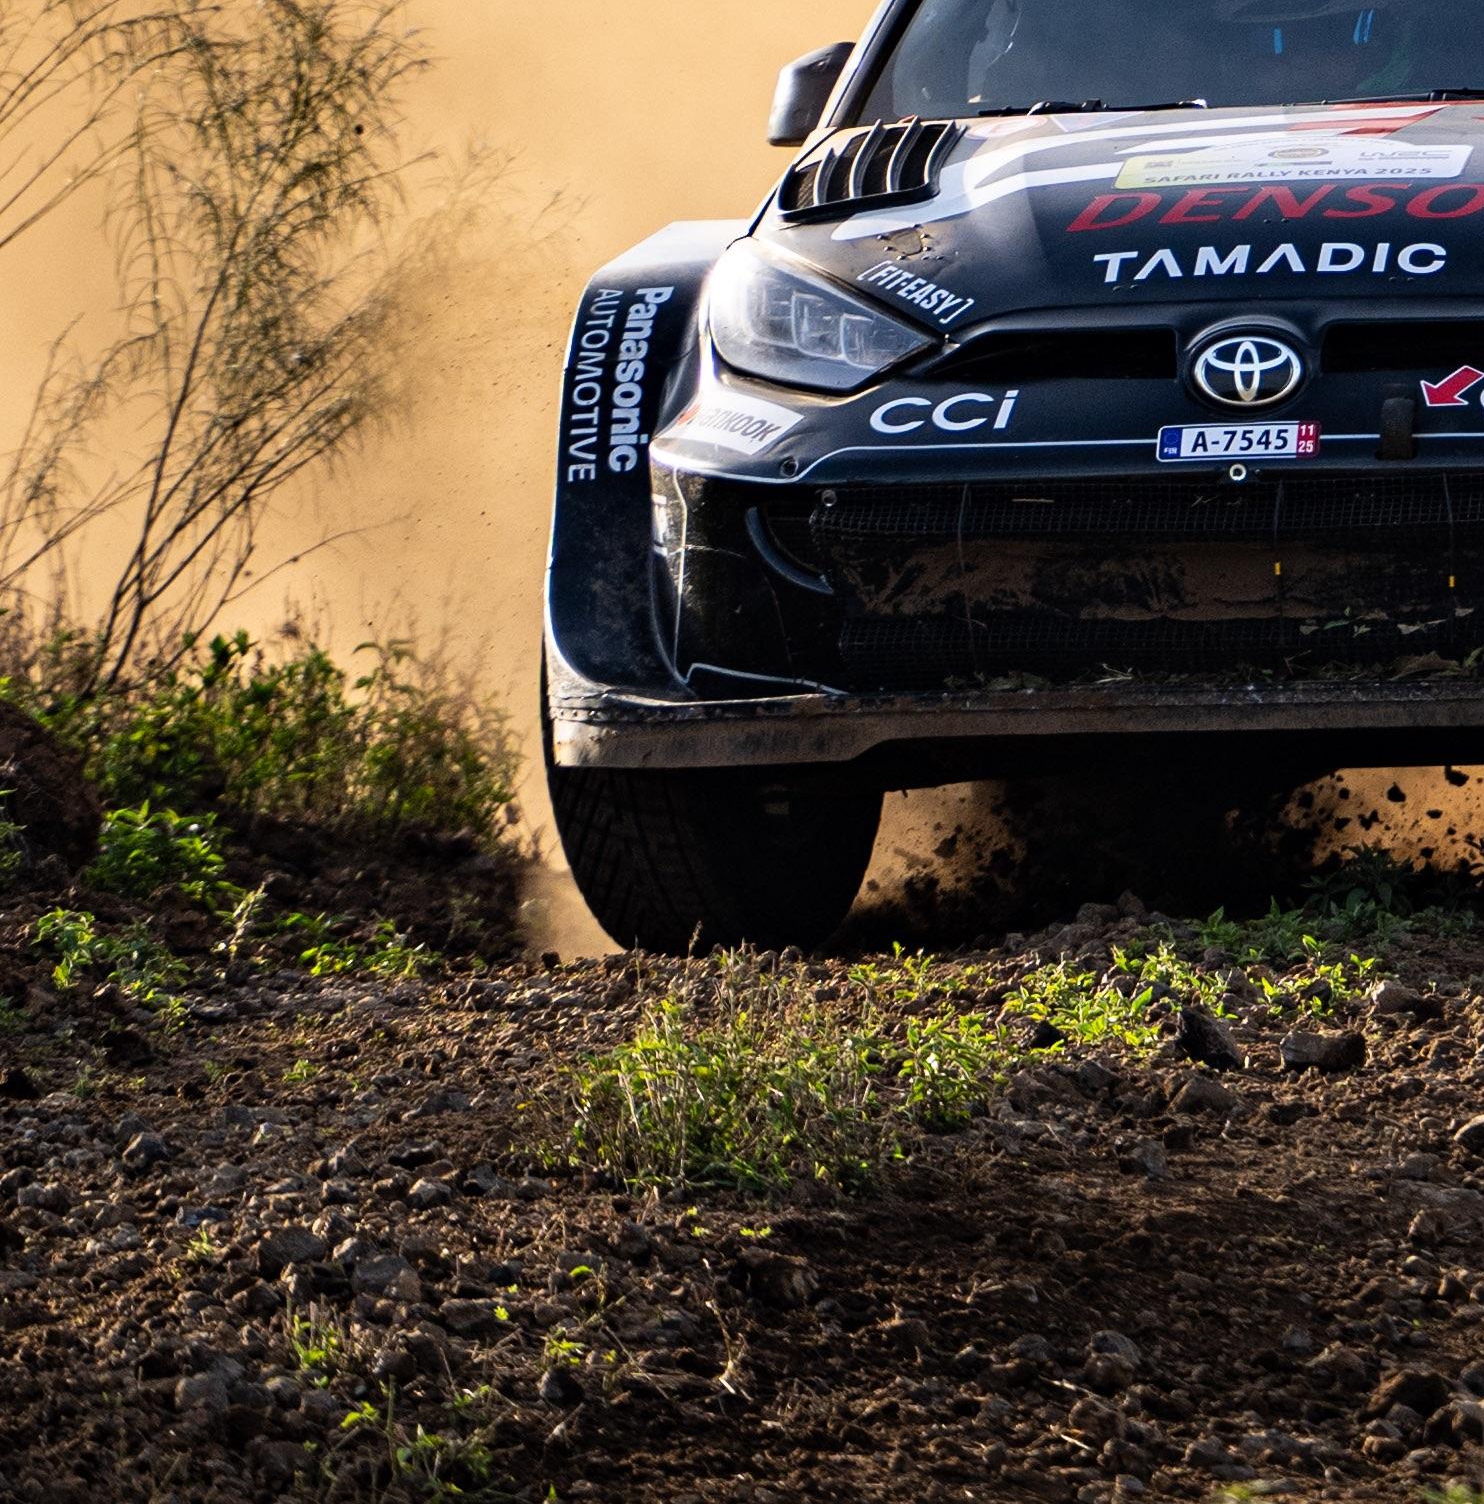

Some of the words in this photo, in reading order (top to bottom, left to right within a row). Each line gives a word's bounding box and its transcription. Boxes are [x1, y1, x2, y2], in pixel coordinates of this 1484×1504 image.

[1144, 172, 1221, 184] SAFARI
[1226, 169, 1293, 179] RALLY
[1298, 167, 1368, 177] KENYA
[1374, 167, 1433, 176] 2025
[1093, 241, 1448, 283] TAMADIC
[567, 288, 624, 483] AUTOMOTIVE
[608, 285, 675, 473] Panasonic
[1190, 428, 1289, 453] A-7545
[1300, 424, 1315, 437] 11
[1298, 440, 1314, 453] 25
